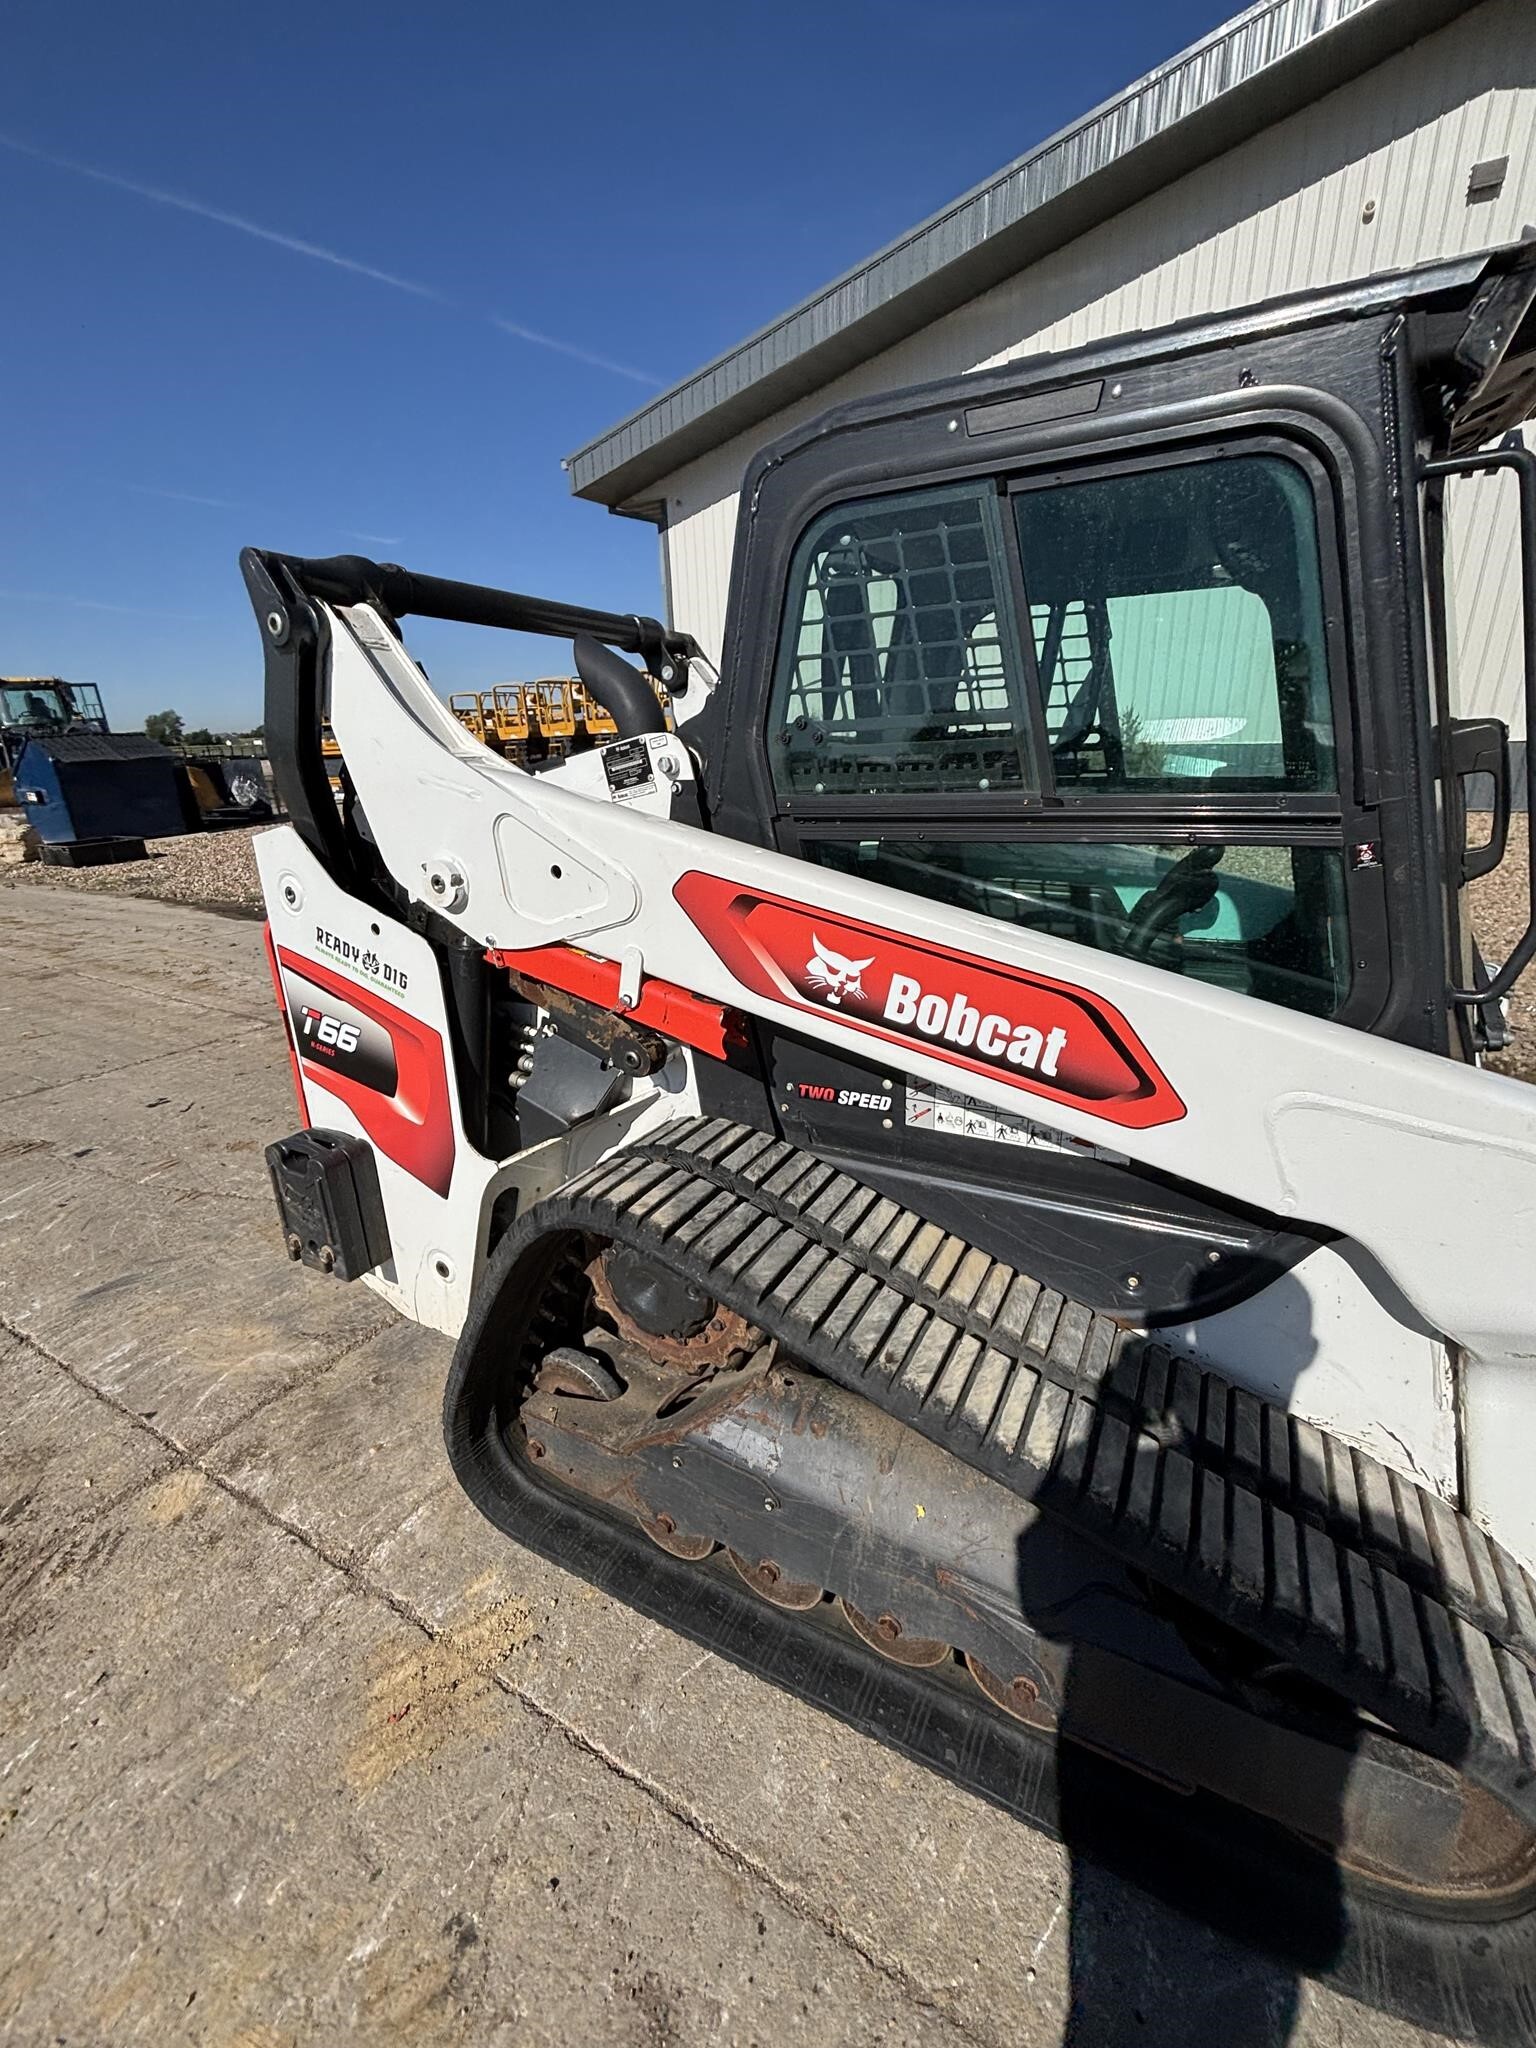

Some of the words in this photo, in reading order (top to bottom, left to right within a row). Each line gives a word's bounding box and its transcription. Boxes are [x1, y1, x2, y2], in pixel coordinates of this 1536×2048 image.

[316, 927, 360, 962] READY
[383, 961, 408, 990] DIG
[301, 1006, 361, 1053] T66
[883, 973, 1067, 1077] Bobcat
[798, 1083, 835, 1102] TWO
[838, 1090, 892, 1112] SPEED
